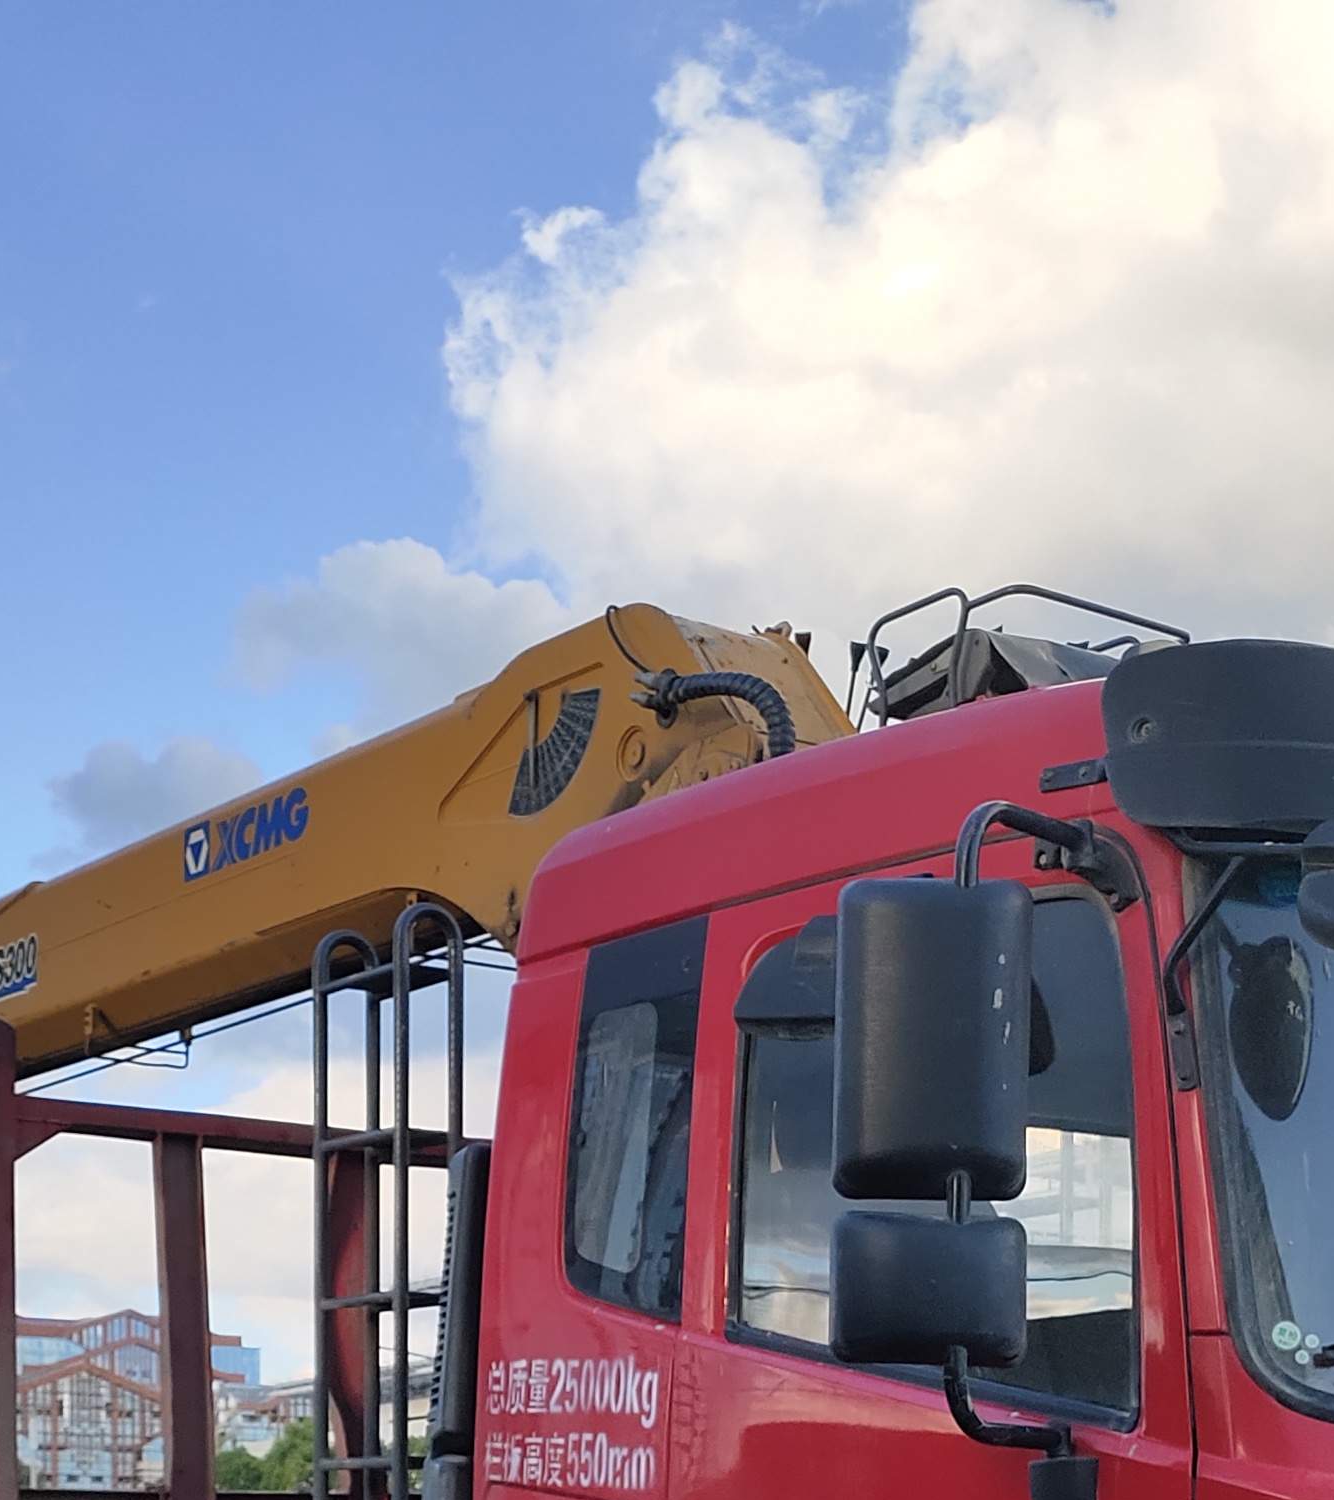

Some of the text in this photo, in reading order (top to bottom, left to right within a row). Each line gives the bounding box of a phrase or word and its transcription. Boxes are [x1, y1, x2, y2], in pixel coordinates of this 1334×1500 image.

[213, 786, 310, 872] XCMG
[486, 1354, 659, 1430] 总质量25000kg
